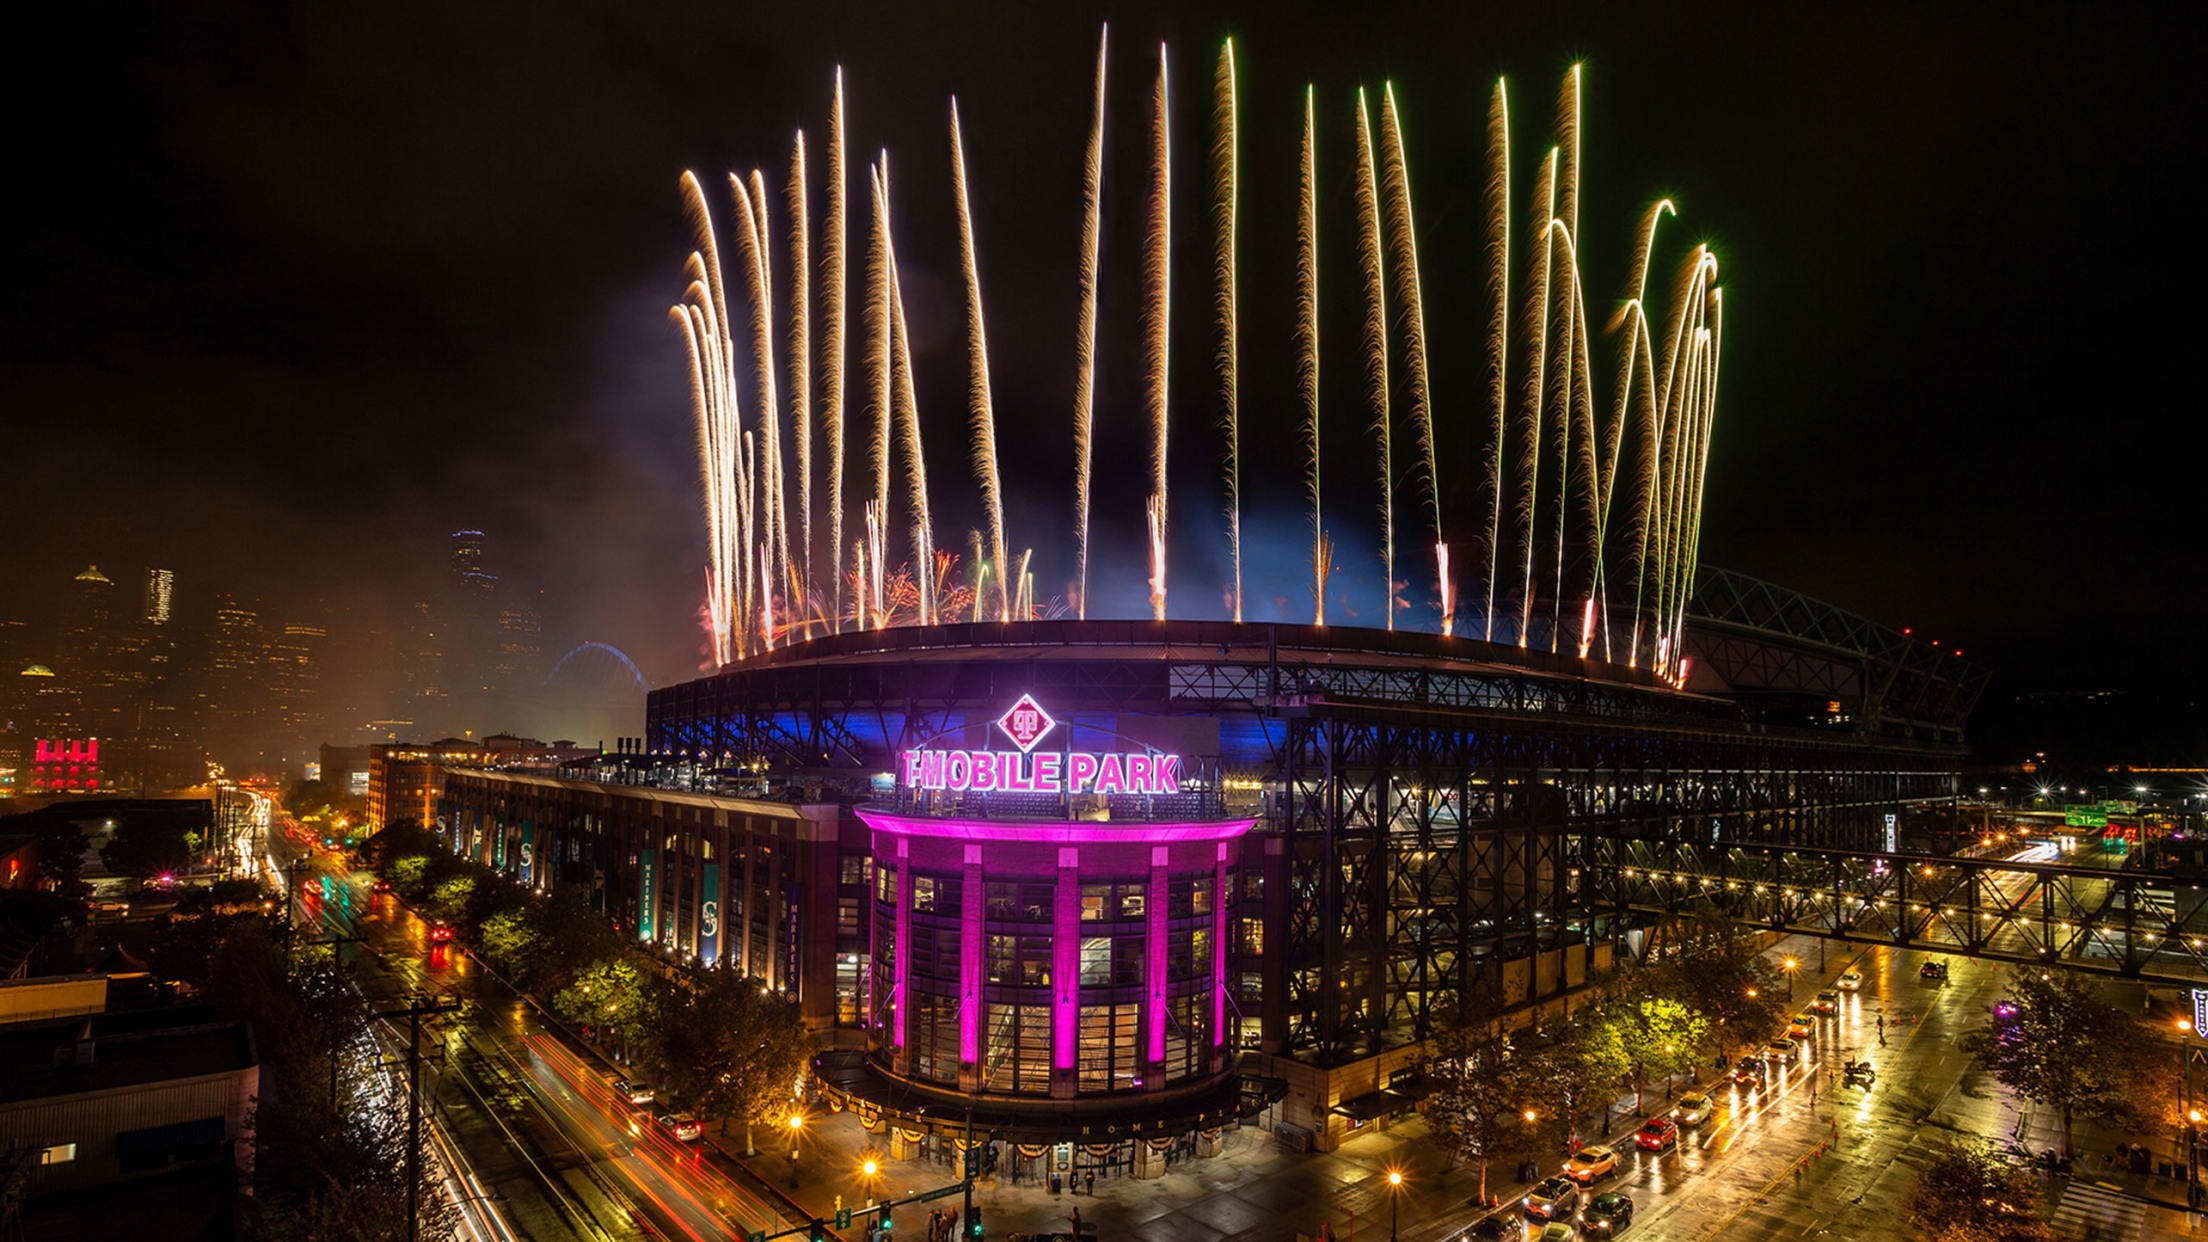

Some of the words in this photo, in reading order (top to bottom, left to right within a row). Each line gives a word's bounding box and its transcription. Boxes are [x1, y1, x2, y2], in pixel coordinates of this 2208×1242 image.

[902, 750, 1061, 793] T-MOBILE
[1068, 752, 1180, 794] PARK
[702, 900, 718, 937] S
[789, 903, 798, 983] MARINERS
[1082, 1120, 1164, 1136] HOME
[1199, 1093, 1269, 1123] PLATE
